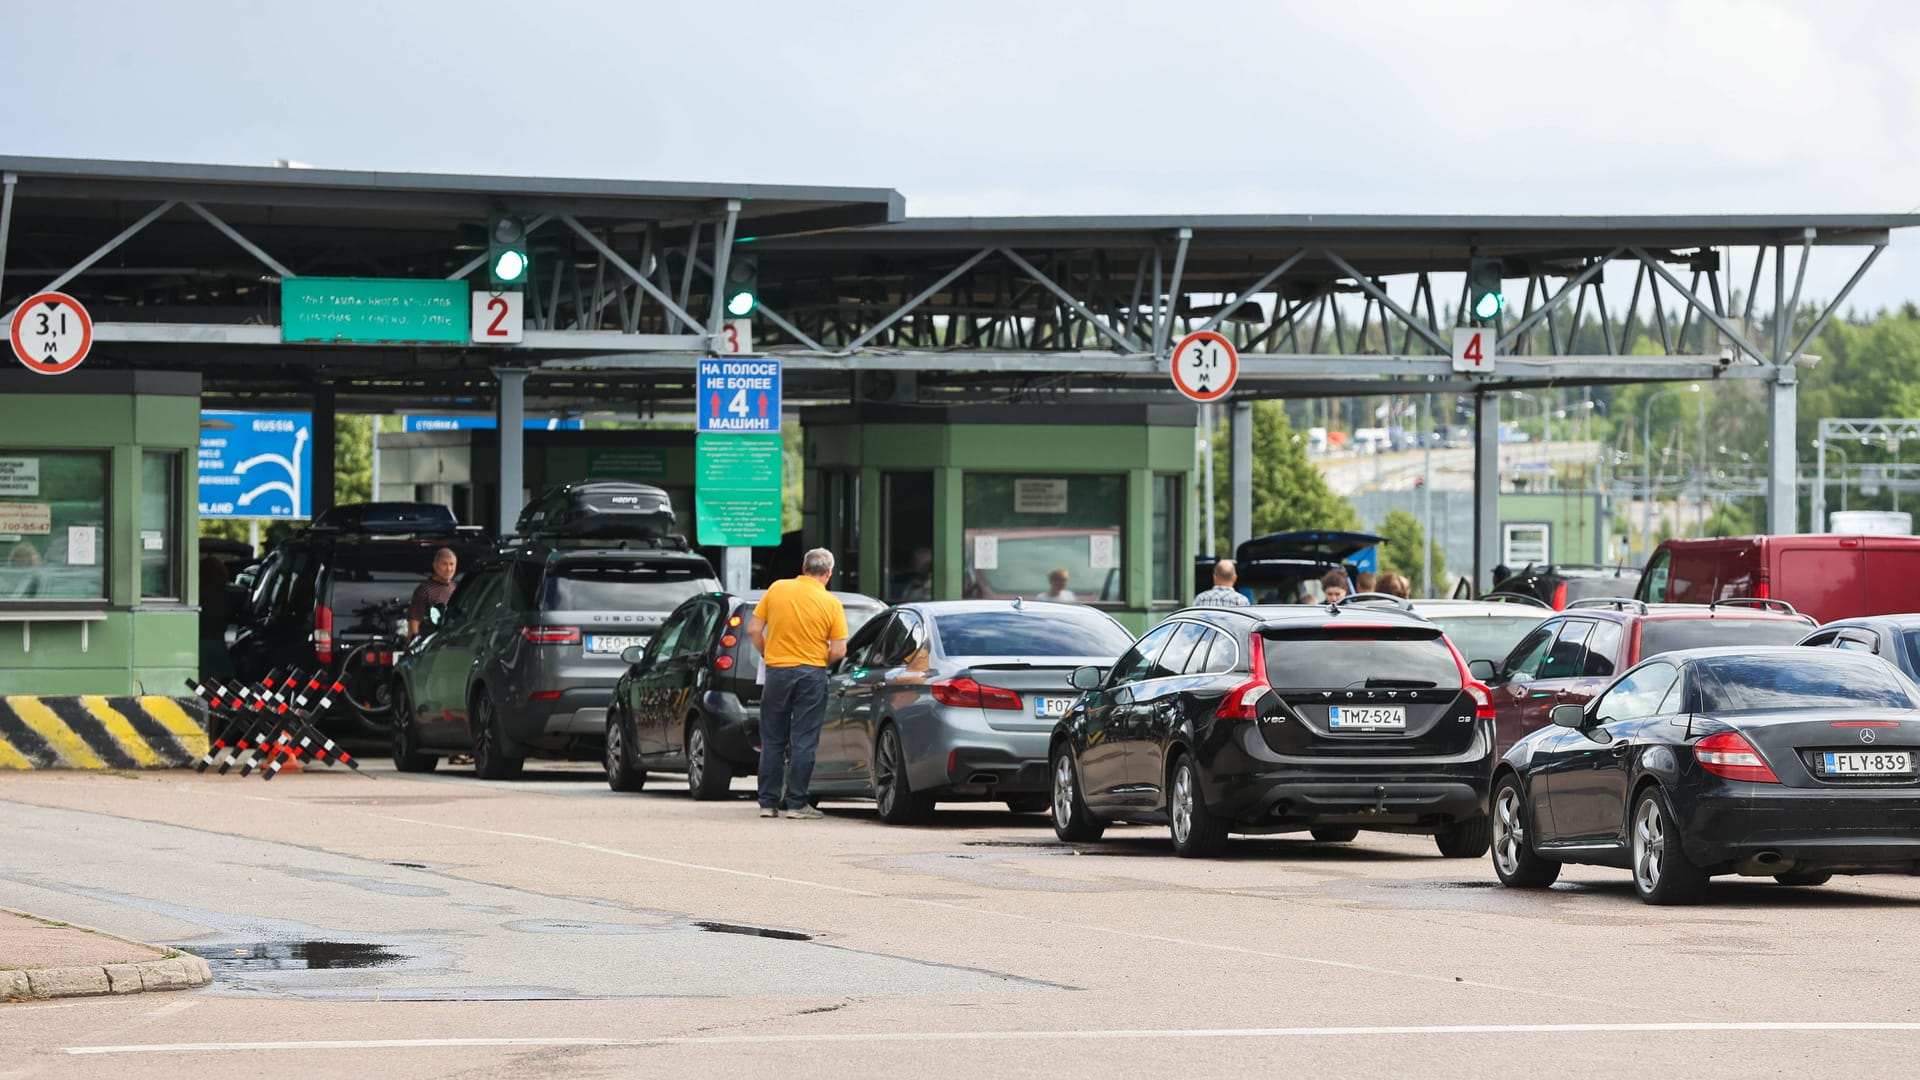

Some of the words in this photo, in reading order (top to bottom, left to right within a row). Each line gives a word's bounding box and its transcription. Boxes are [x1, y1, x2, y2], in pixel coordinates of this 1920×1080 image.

[36, 312, 66, 338] 3,1
[487, 297, 508, 336] 2
[722, 324, 739, 353] 3
[1463, 332, 1483, 366] 4
[1192, 348, 1217, 369] 3,1
[702, 364, 720, 375] НА
[723, 364, 777, 375] ПОЛОСЕ
[707, 378, 725, 389] НЕ
[727, 378, 772, 389] БОЛЕЕ
[728, 389, 750, 417] 4
[252, 419, 295, 432] RUSSIA
[708, 418, 770, 429] МАШИН!
[1341, 709, 1401, 723] TMZ-524
[1838, 755, 1906, 771] FLY-839
